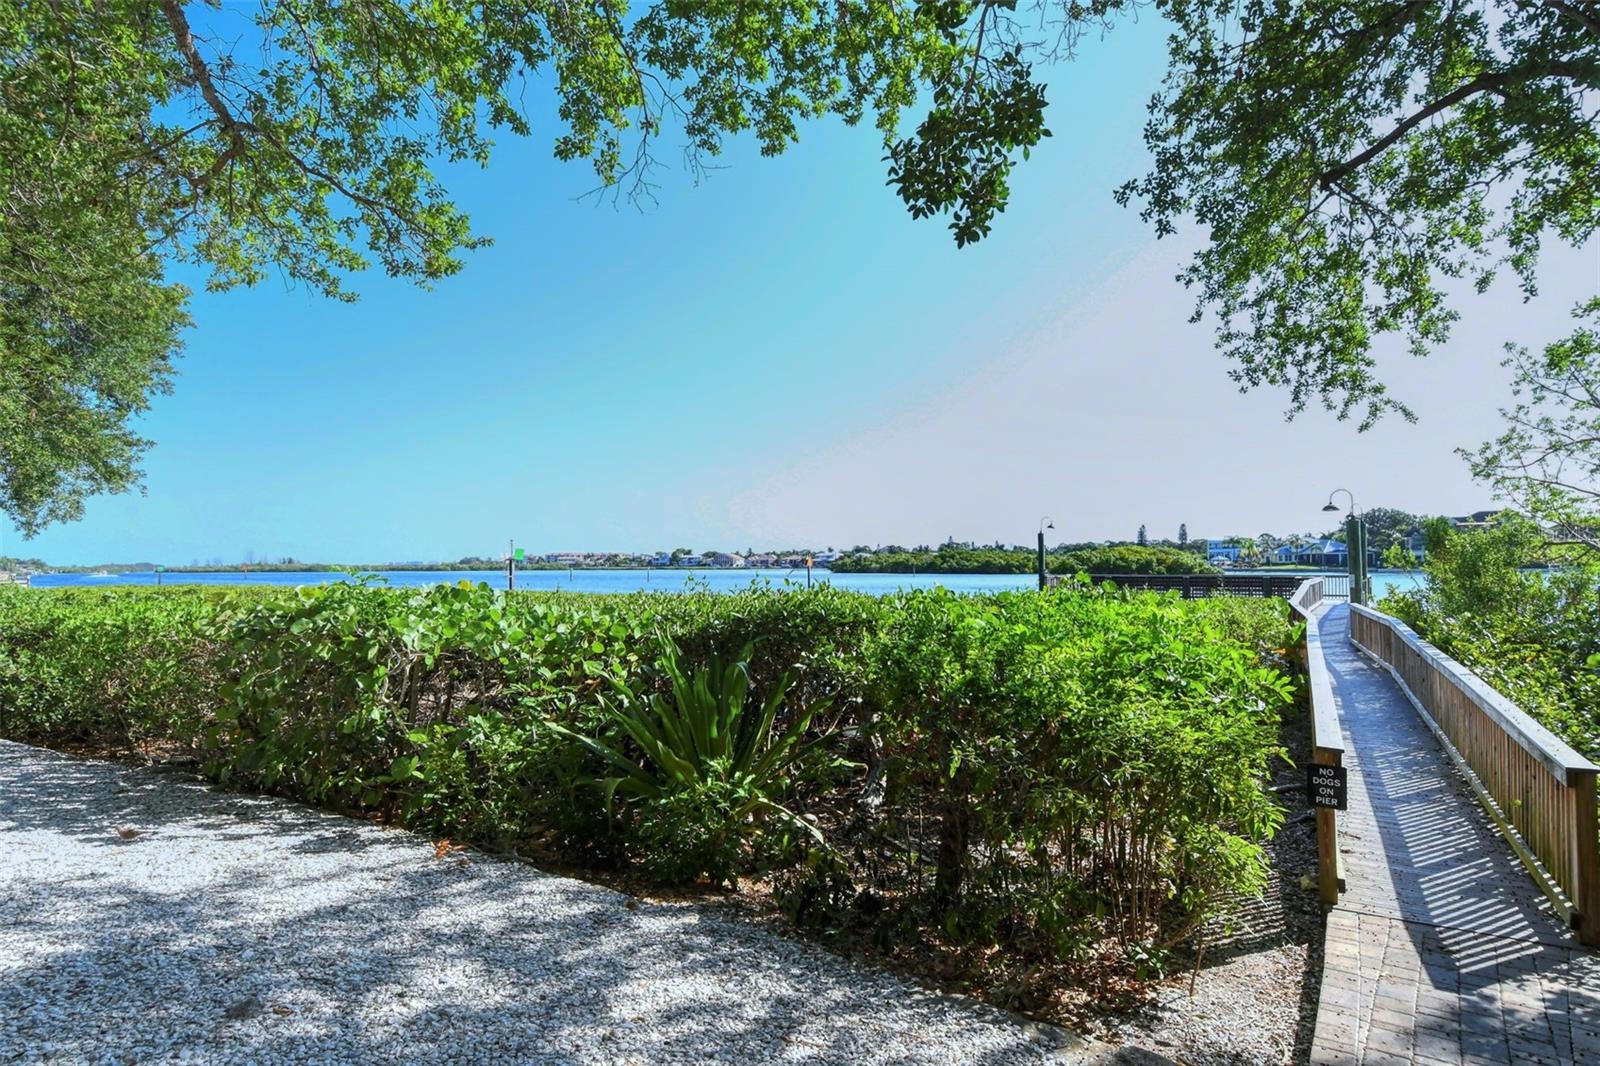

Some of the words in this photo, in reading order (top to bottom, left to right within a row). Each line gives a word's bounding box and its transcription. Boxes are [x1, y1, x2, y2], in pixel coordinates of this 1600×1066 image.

[1319, 768, 1334, 776] NO
[1313, 777, 1341, 787] DOGS
[1319, 787, 1334, 795] ON
[1316, 796, 1338, 806] PIER
